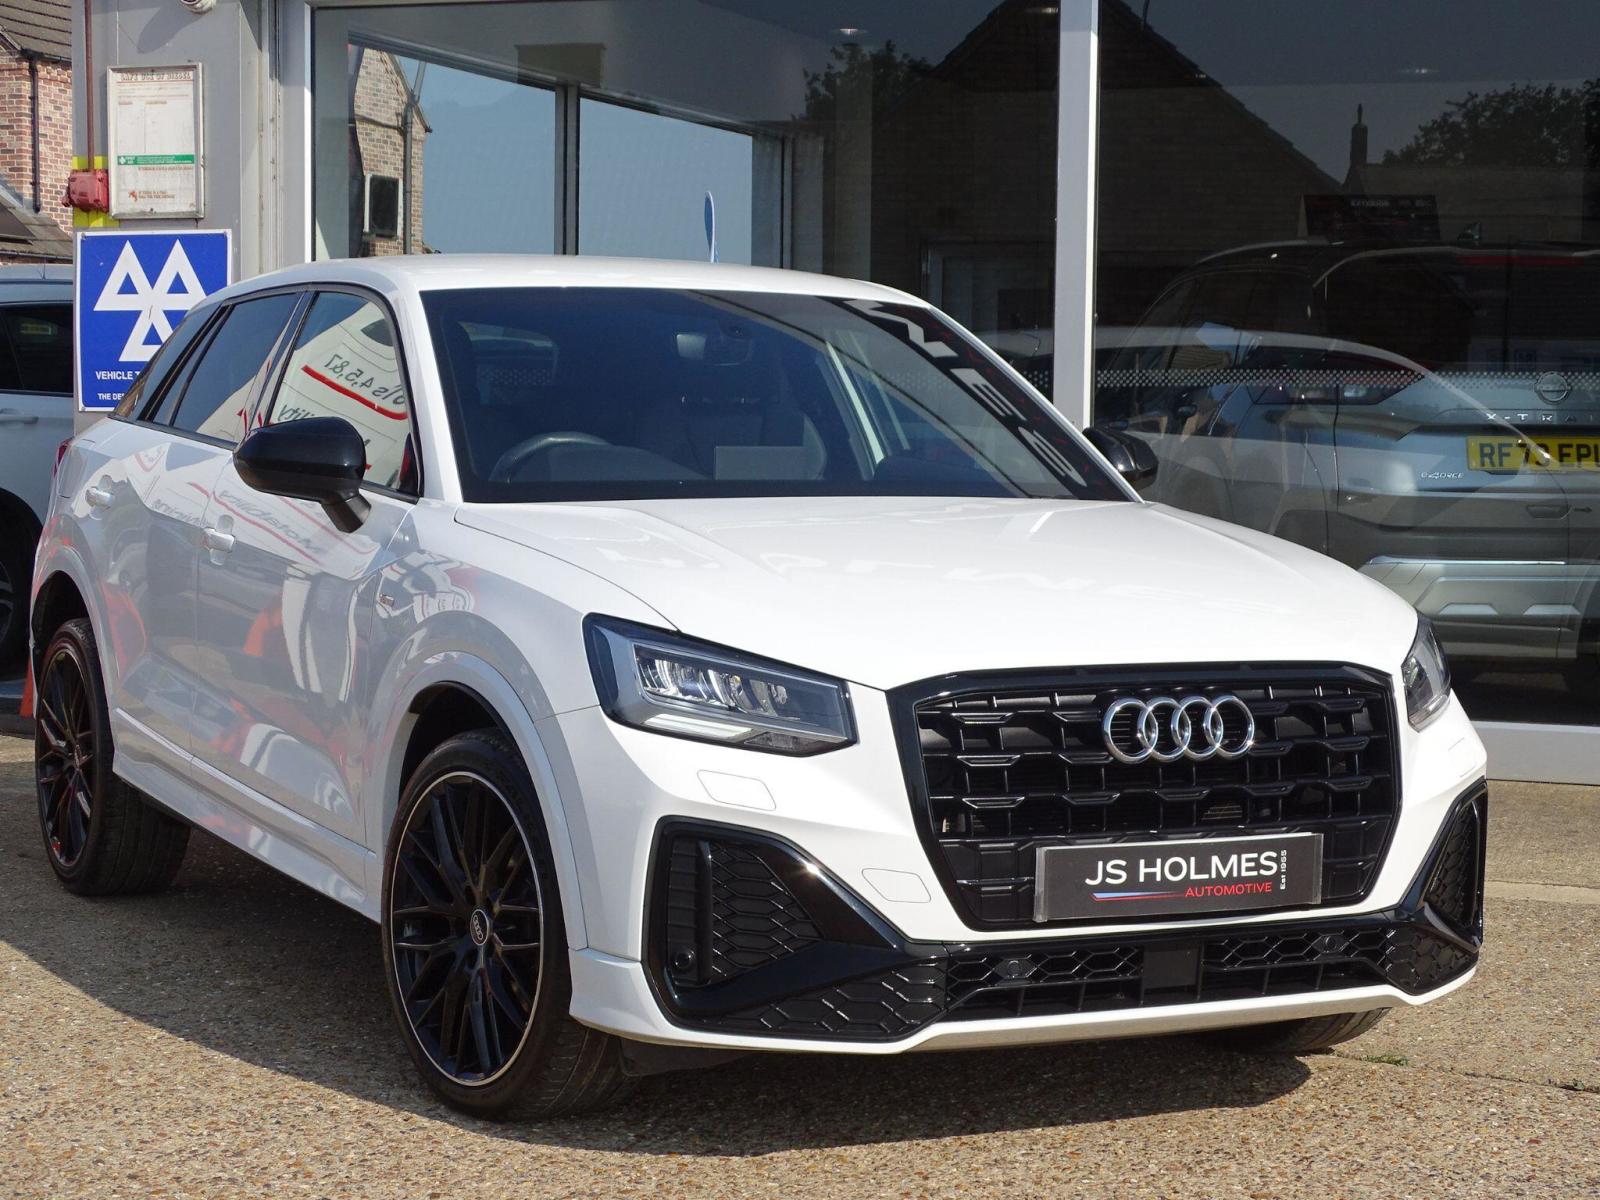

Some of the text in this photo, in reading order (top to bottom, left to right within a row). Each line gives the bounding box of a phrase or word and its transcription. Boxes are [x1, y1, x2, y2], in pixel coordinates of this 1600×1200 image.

[95, 371, 134, 380] VEHICLE
[1084, 851, 1278, 885] JS HOLMES
[1185, 882, 1273, 897] AUTOMOTIVE
